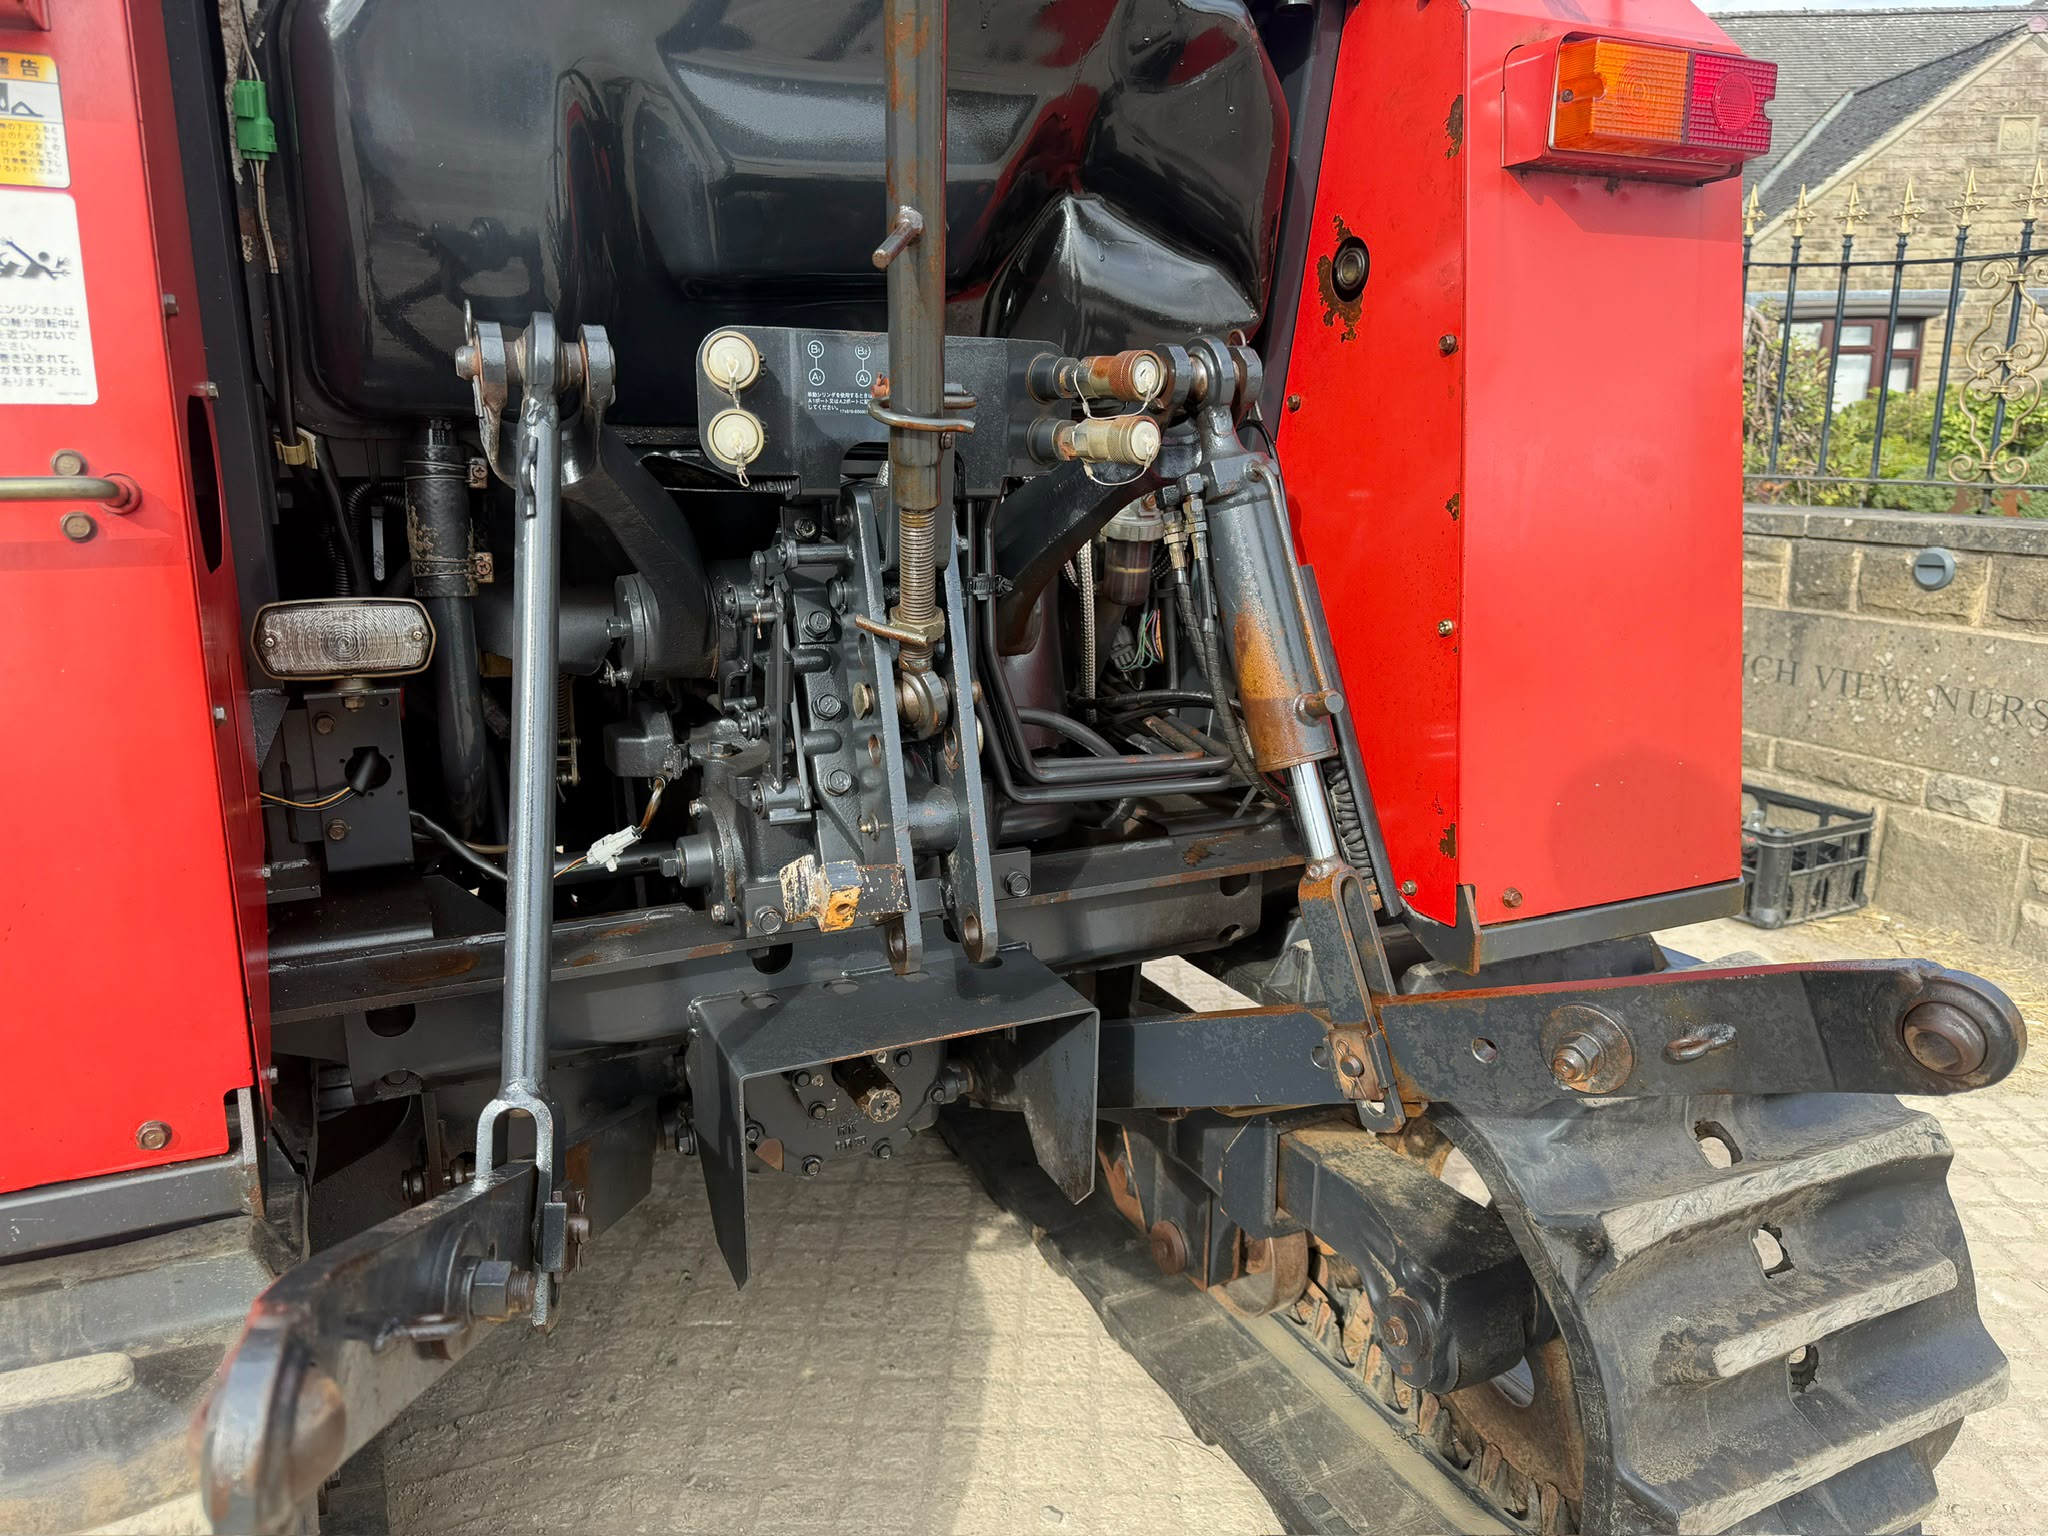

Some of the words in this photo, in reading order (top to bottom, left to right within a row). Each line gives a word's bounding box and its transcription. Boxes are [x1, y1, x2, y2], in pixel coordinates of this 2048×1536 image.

[0, 305, 74, 316] ンジンまたは
[1815, 664, 1914, 706] VIEW
